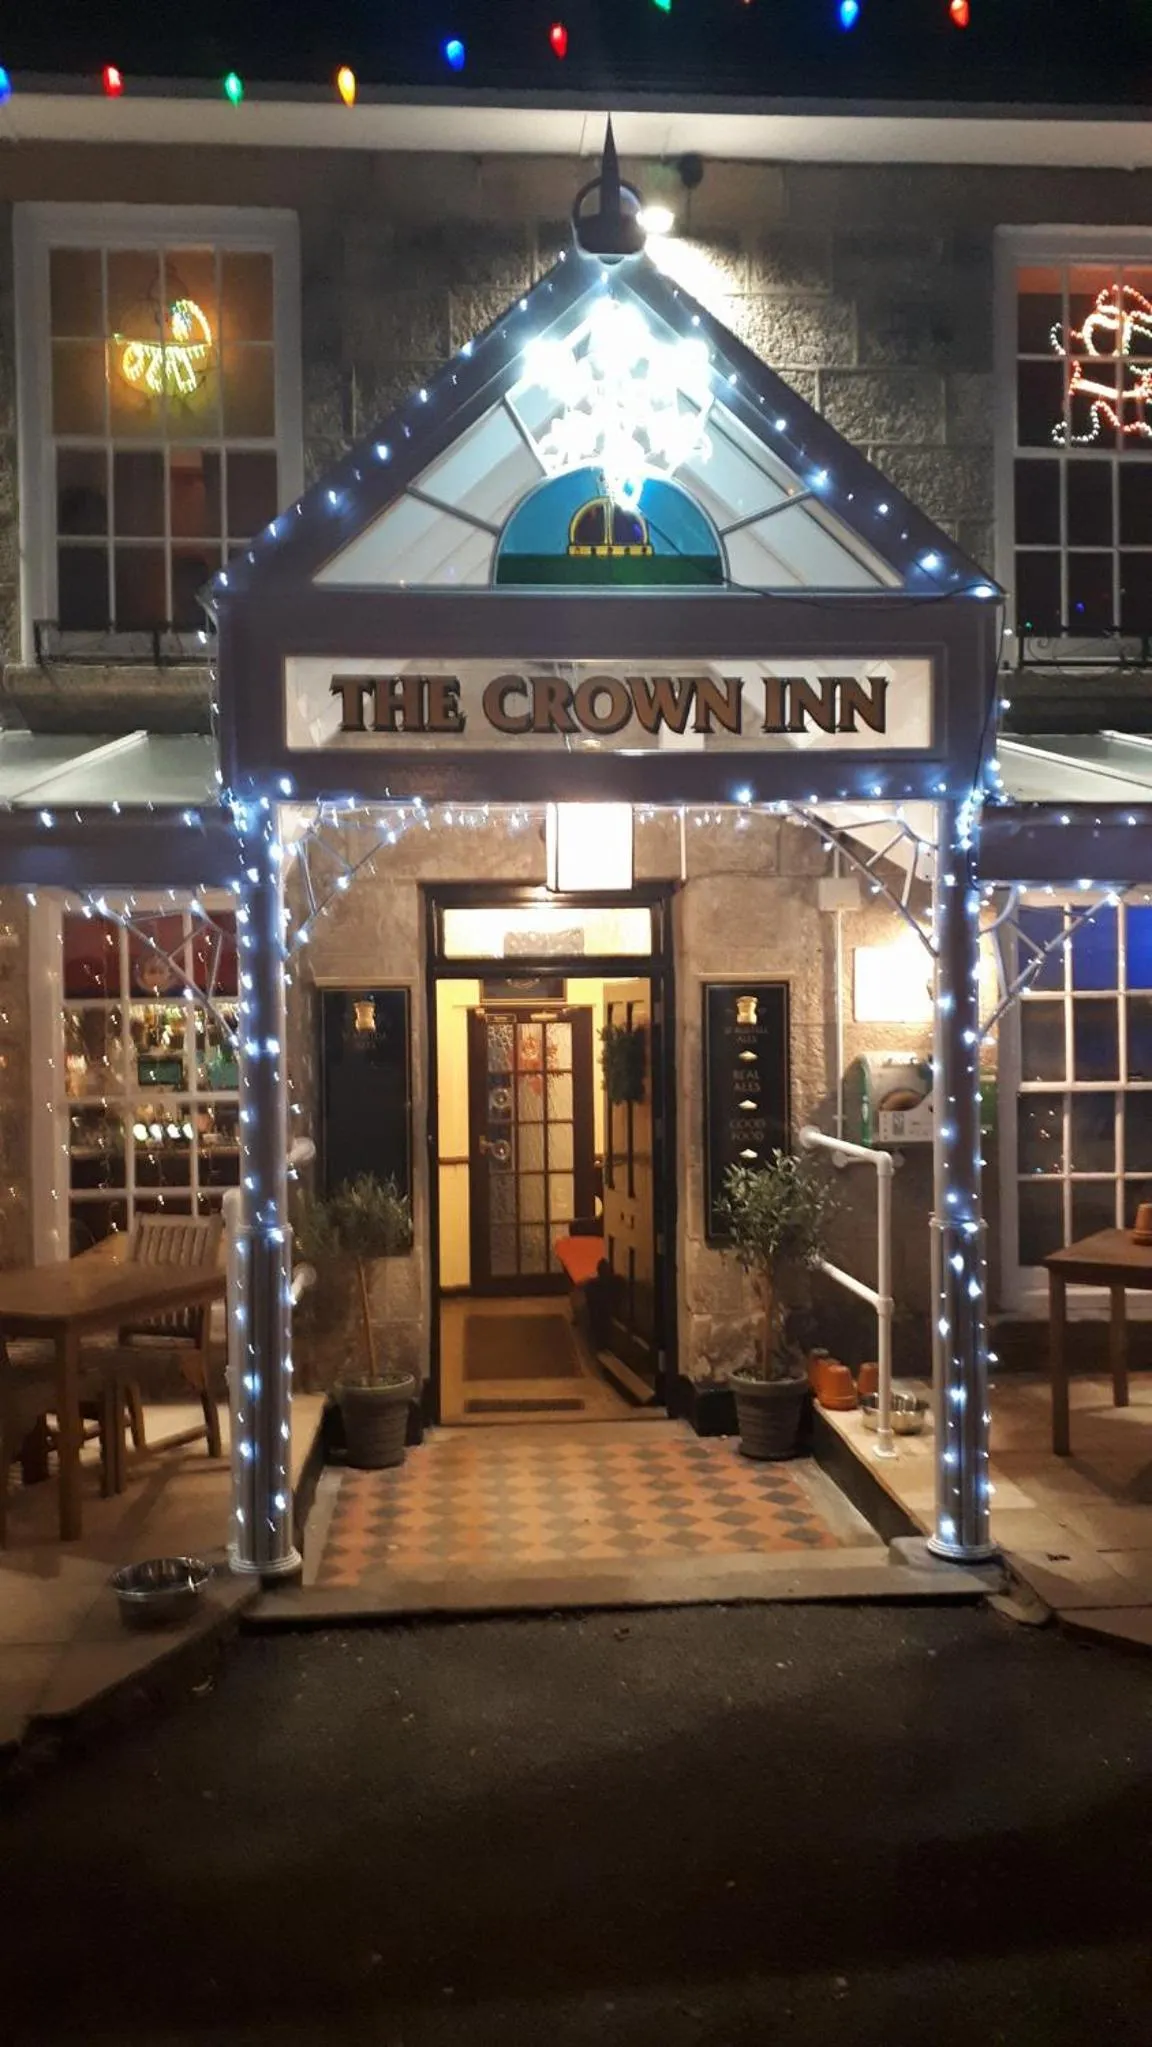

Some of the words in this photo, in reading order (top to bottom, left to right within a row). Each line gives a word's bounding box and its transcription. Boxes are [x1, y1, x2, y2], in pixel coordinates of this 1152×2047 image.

[330, 675, 467, 735] THE
[482, 675, 744, 735] CROWN
[760, 677, 888, 735] INN
